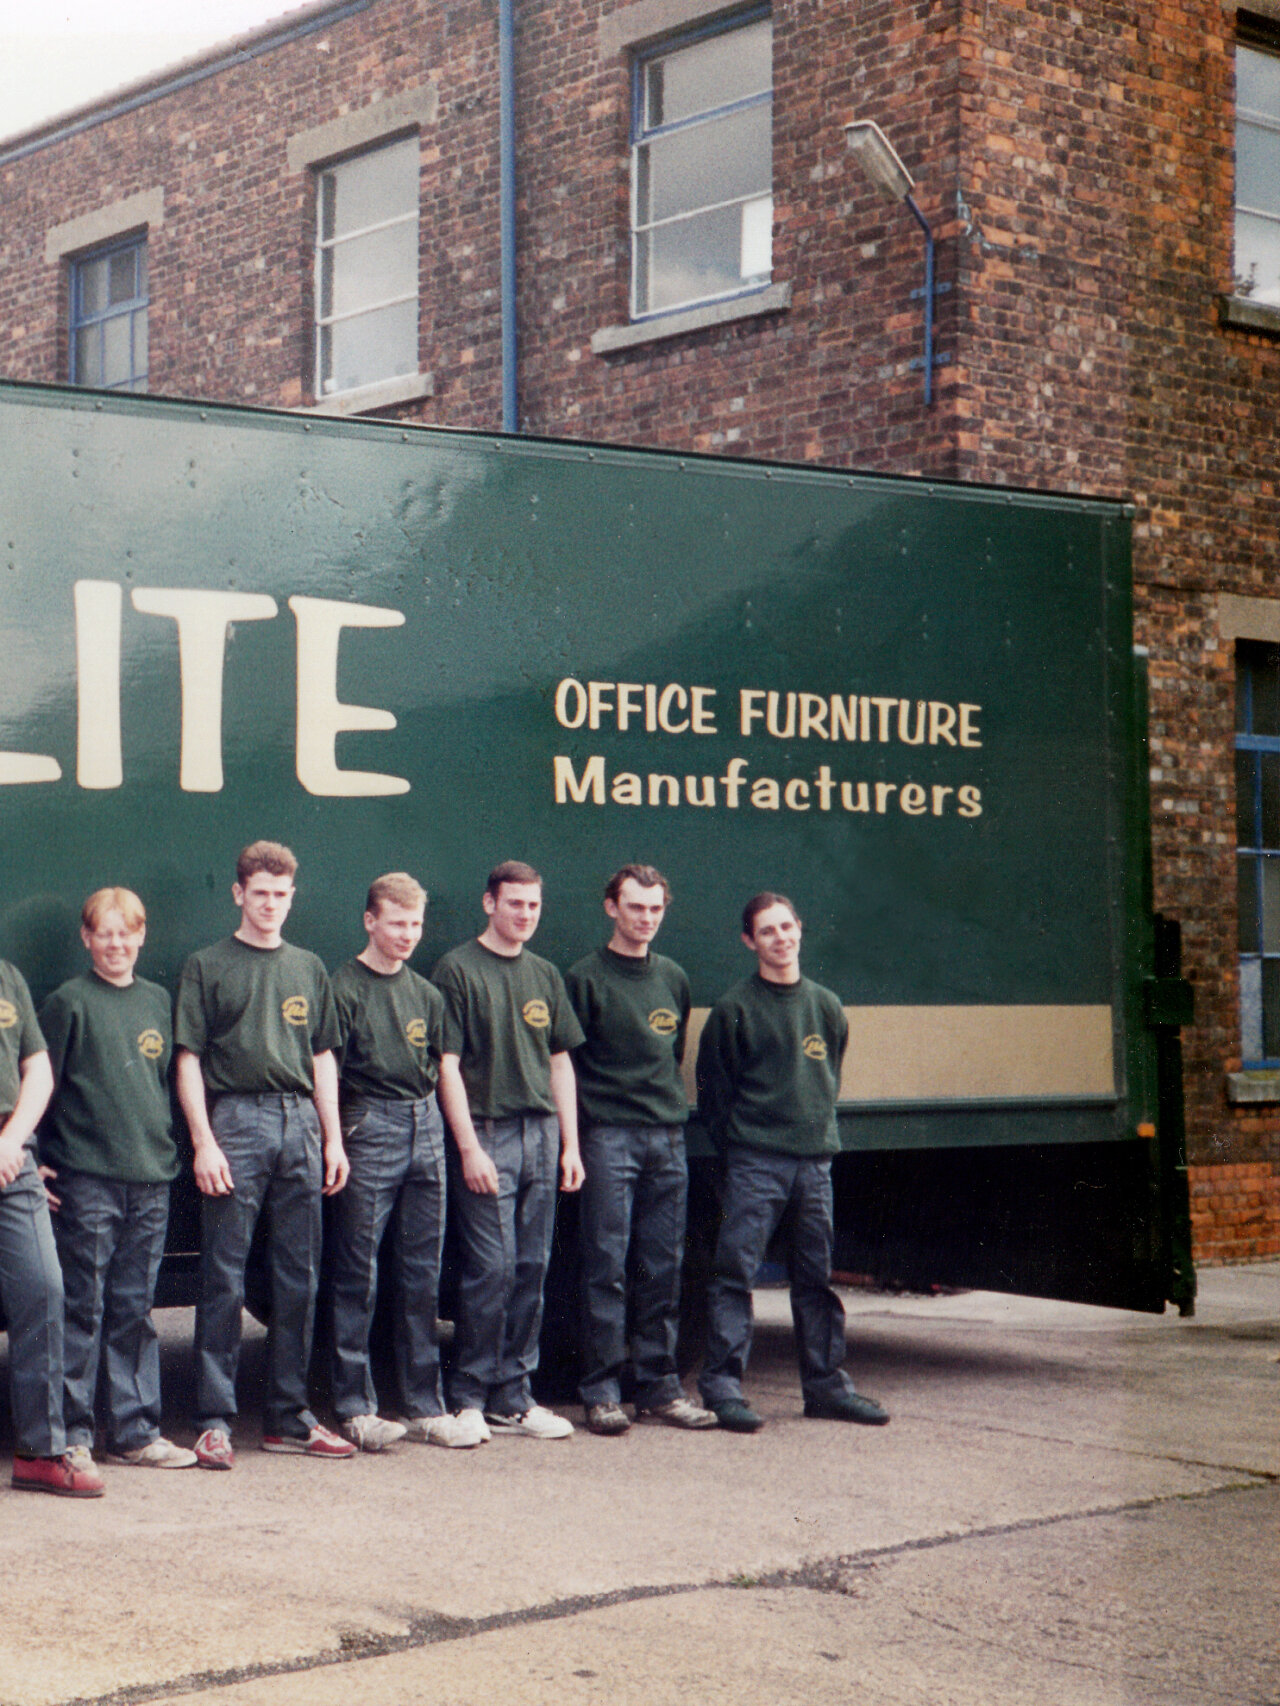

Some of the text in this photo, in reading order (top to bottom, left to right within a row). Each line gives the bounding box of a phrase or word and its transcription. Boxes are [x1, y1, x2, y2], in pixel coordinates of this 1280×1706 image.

[554, 677, 984, 748] OFFICE FURNITURE
[553, 755, 984, 818] Manufacturers
